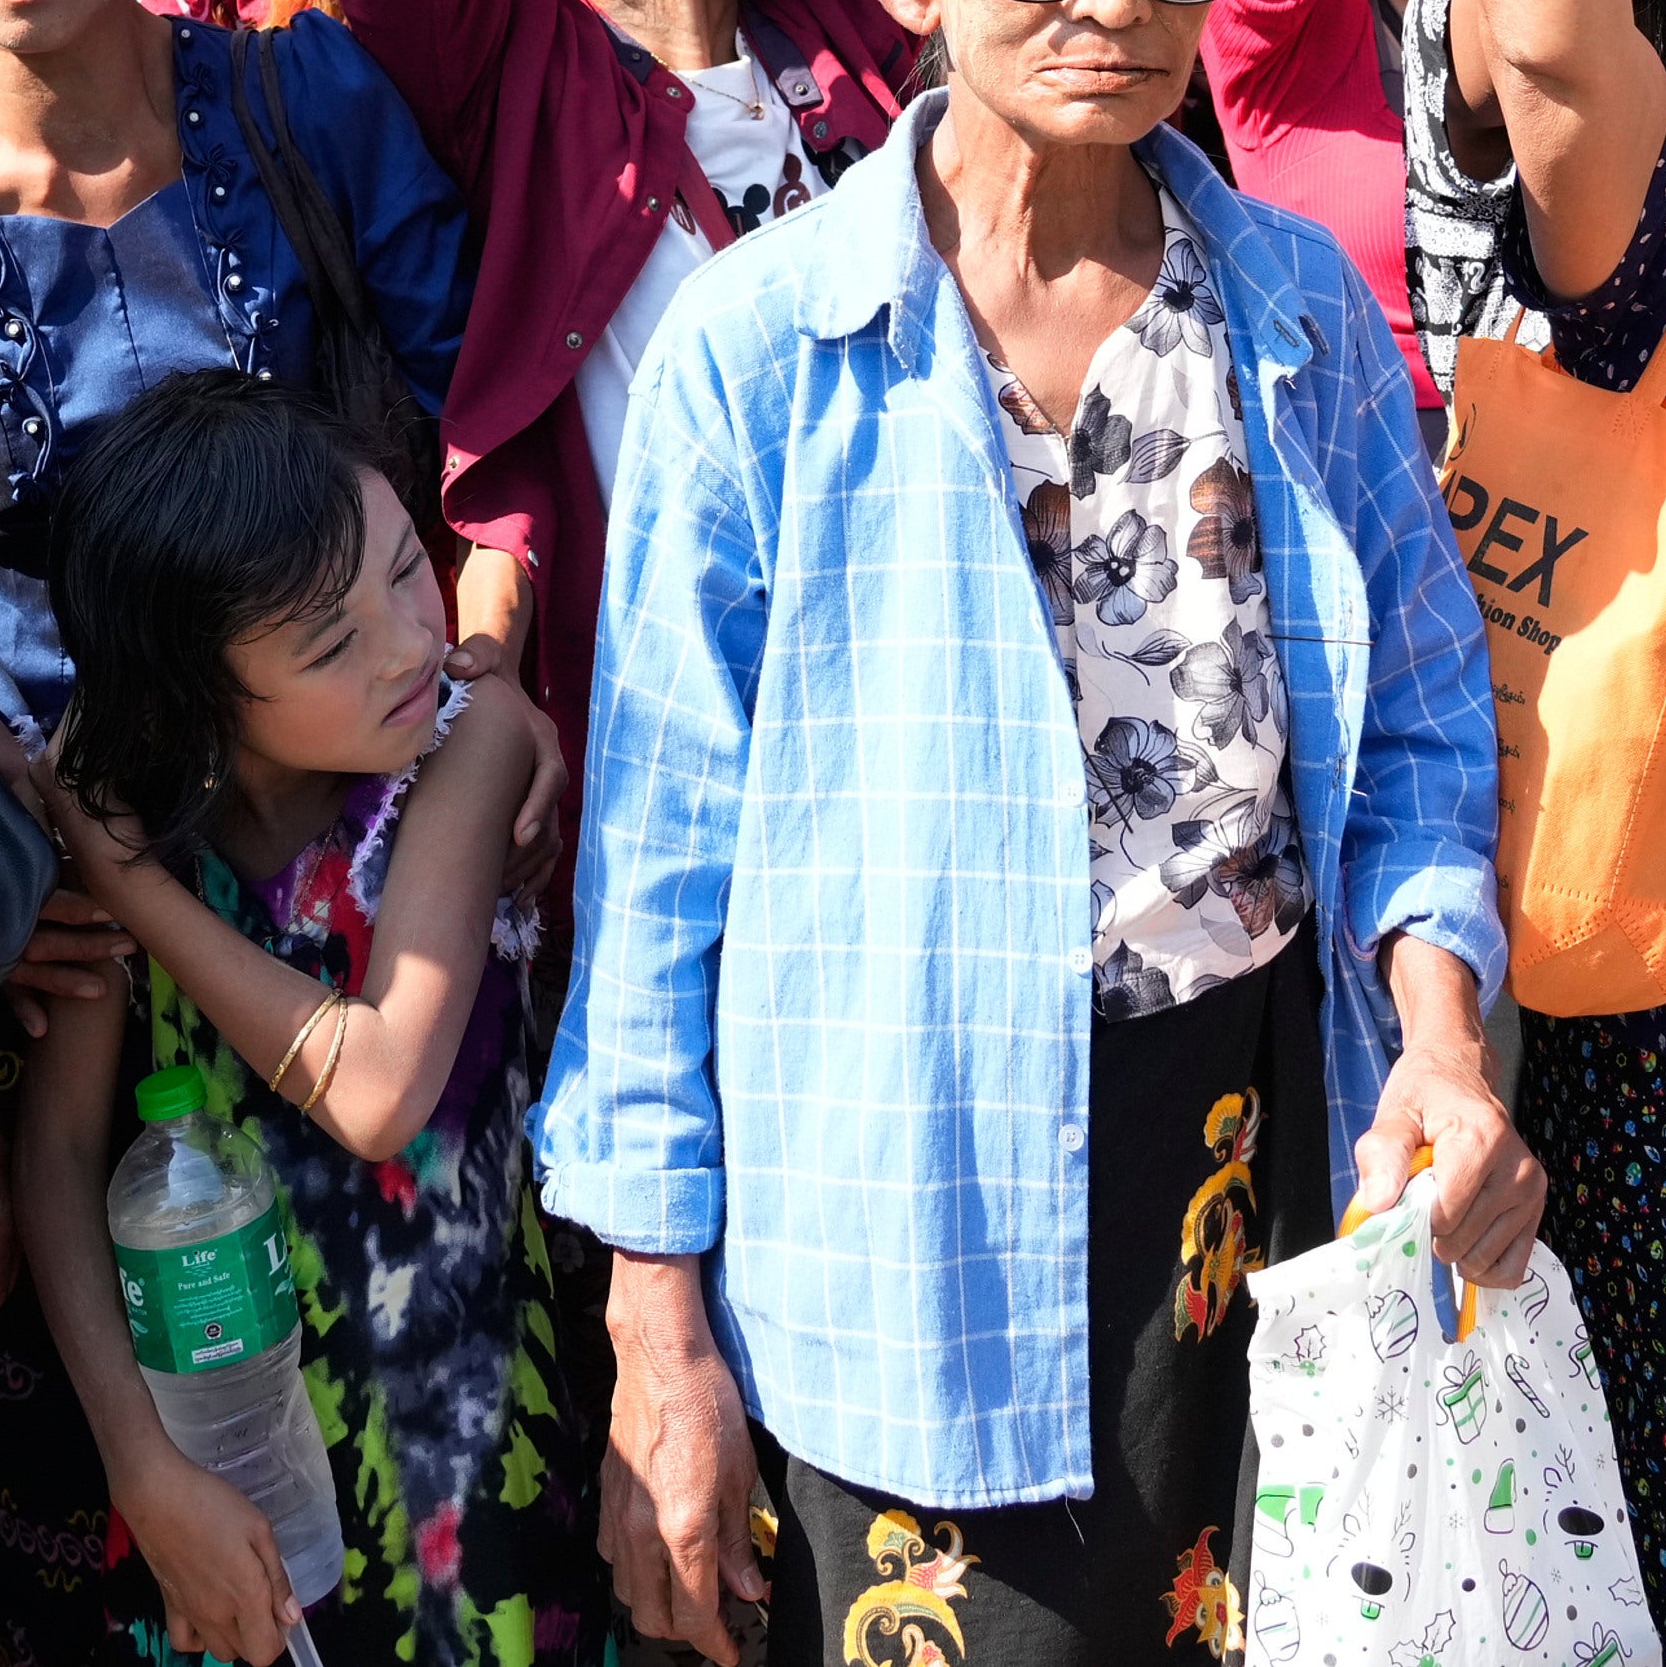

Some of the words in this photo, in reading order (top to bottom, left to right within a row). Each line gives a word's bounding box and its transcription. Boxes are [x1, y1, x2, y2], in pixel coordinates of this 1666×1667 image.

[1516, 615, 1563, 656] Shop
[181, 1249, 217, 1267] Life
[198, 1276, 213, 1287] and
